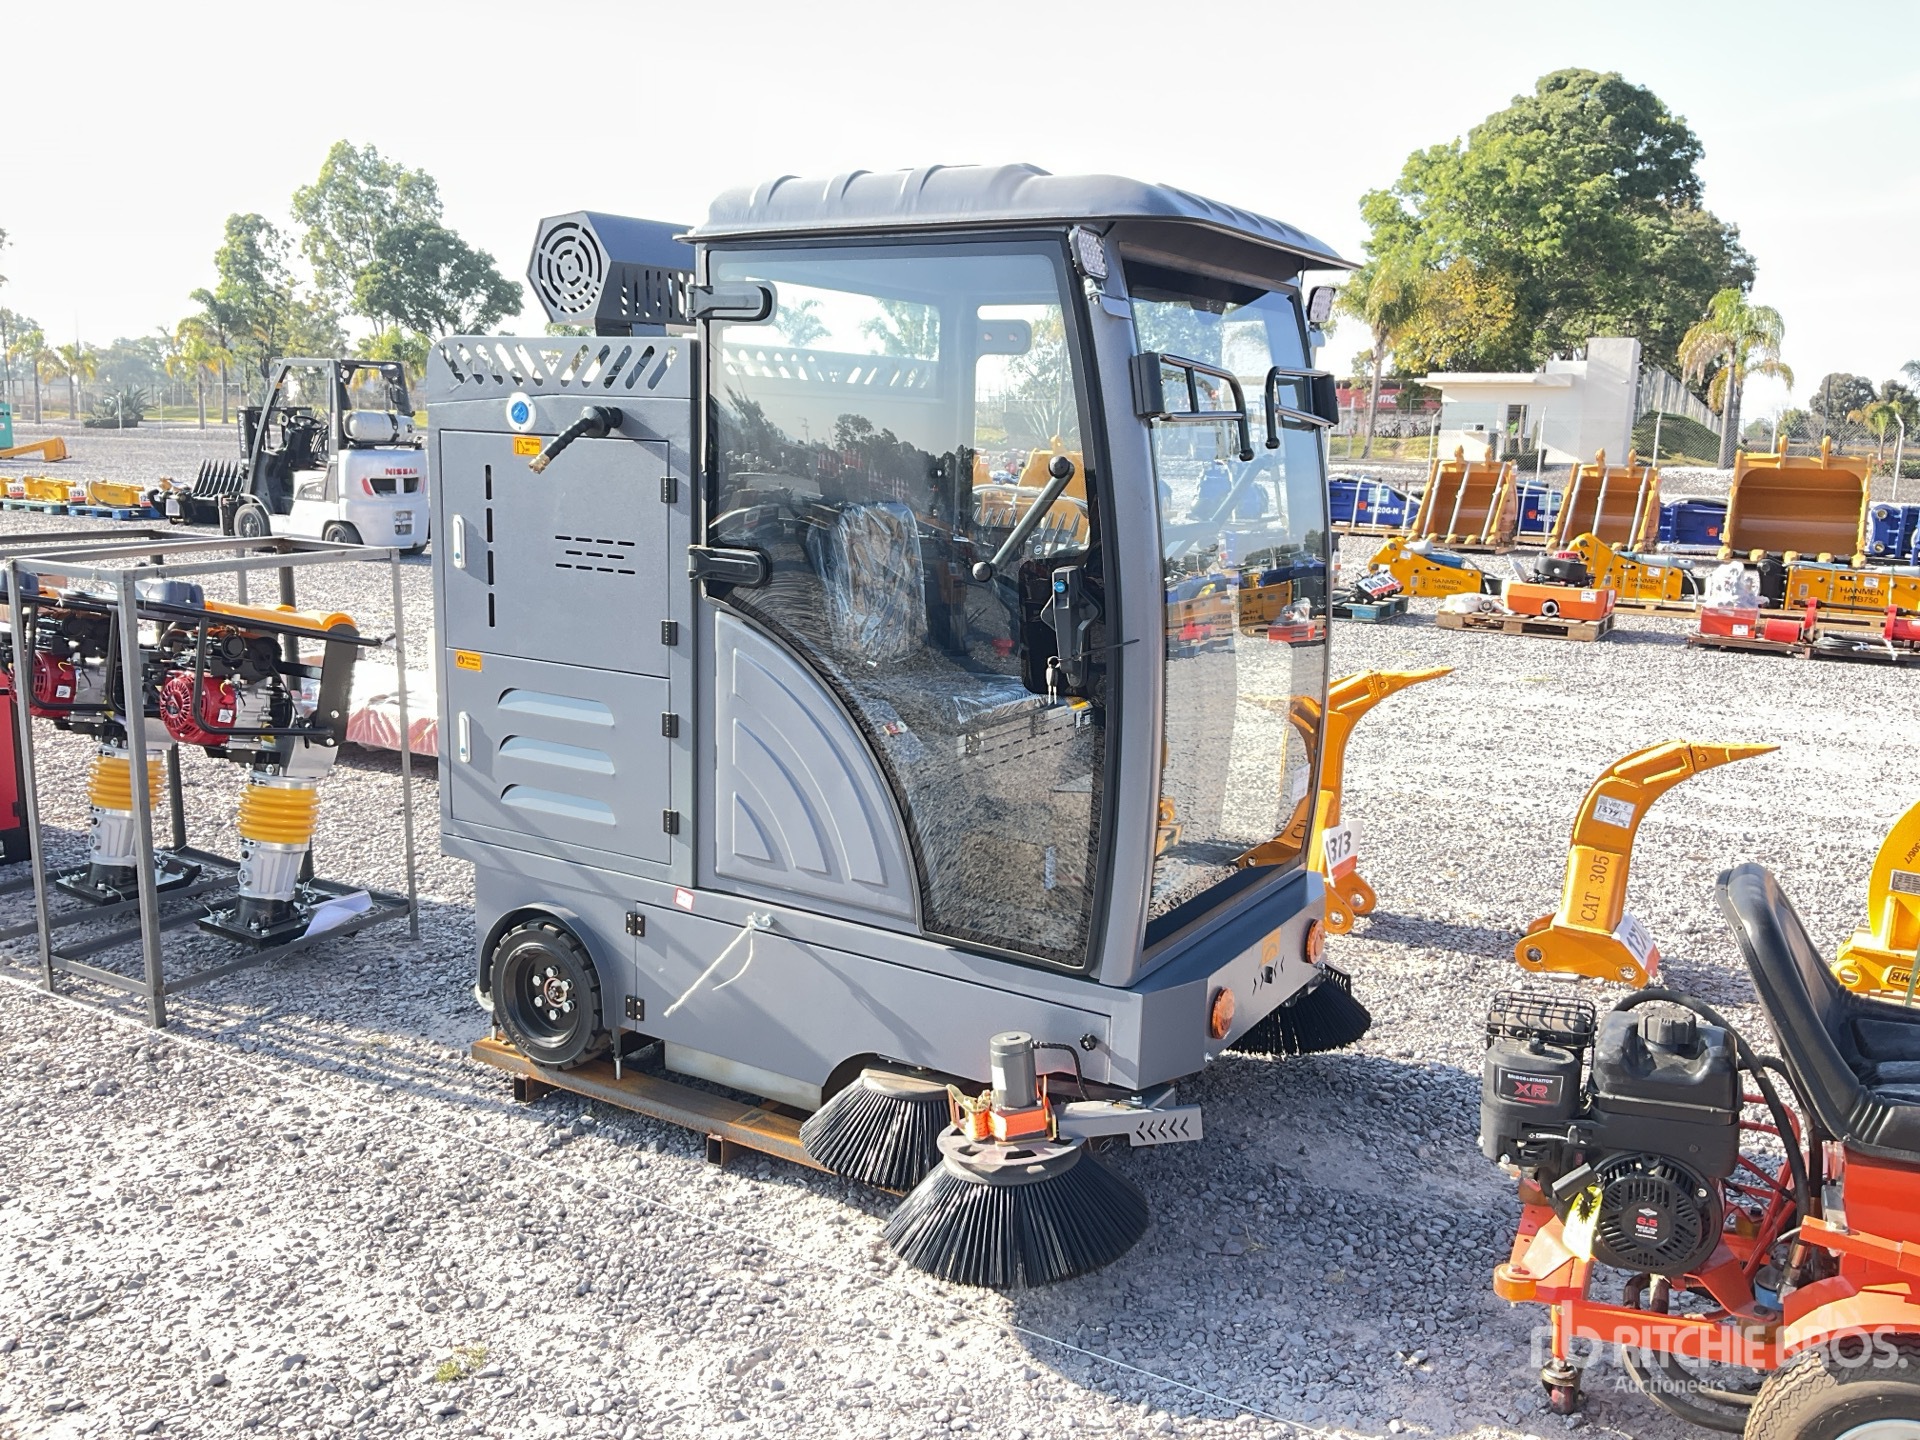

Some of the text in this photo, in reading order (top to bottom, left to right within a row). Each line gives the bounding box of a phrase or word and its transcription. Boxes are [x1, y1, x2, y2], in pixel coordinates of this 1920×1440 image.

[70, 490, 85, 498] 1293
[1839, 586, 1885, 597] HANMEN
[1843, 595, 1879, 604] HMB750
[1581, 855, 1610, 922] CAT 305
[1514, 1081, 1548, 1099] XR
[1636, 1216, 1658, 1228] 6.5
